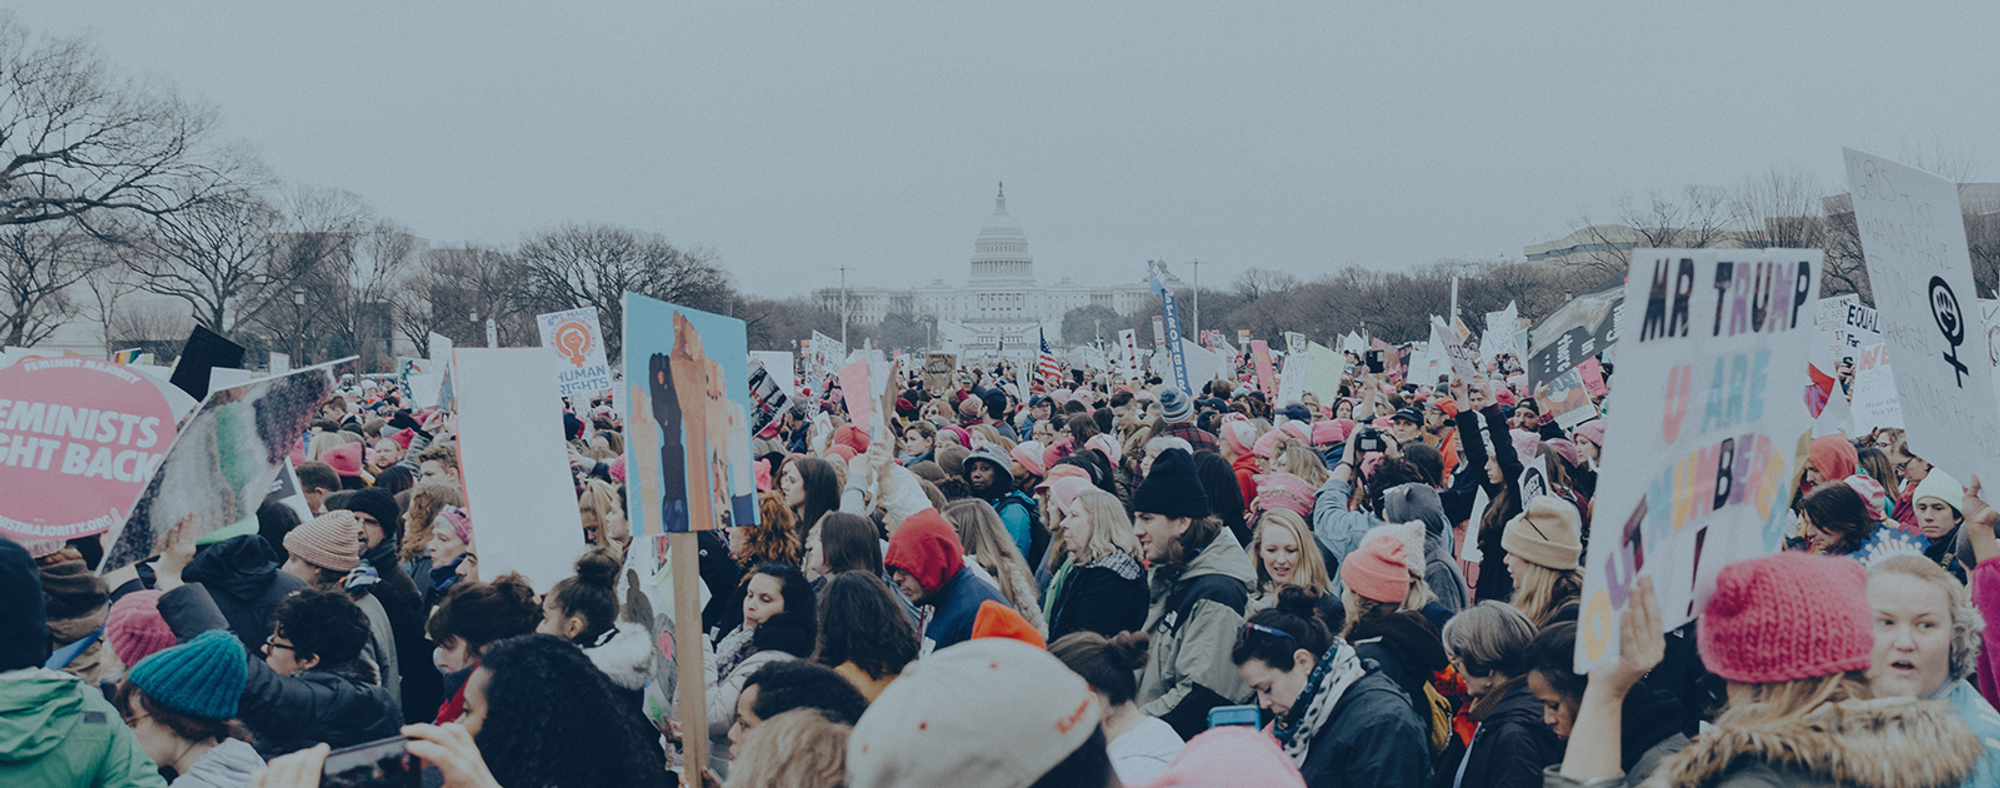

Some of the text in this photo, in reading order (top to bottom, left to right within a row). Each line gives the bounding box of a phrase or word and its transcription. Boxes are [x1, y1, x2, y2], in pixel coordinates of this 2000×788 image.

[1640, 258, 1810, 342] MR TRUMP
[1846, 304, 1880, 334] EQUAL
[1164, 292, 1187, 391] STRONGER
[24, 358, 142, 384] FEMINIST MAJORITY
[558, 365, 606, 383] HUMAN
[560, 377, 609, 395] RIGHTS
[1662, 348, 1772, 445] U ARE
[60, 442, 164, 483] BACK
